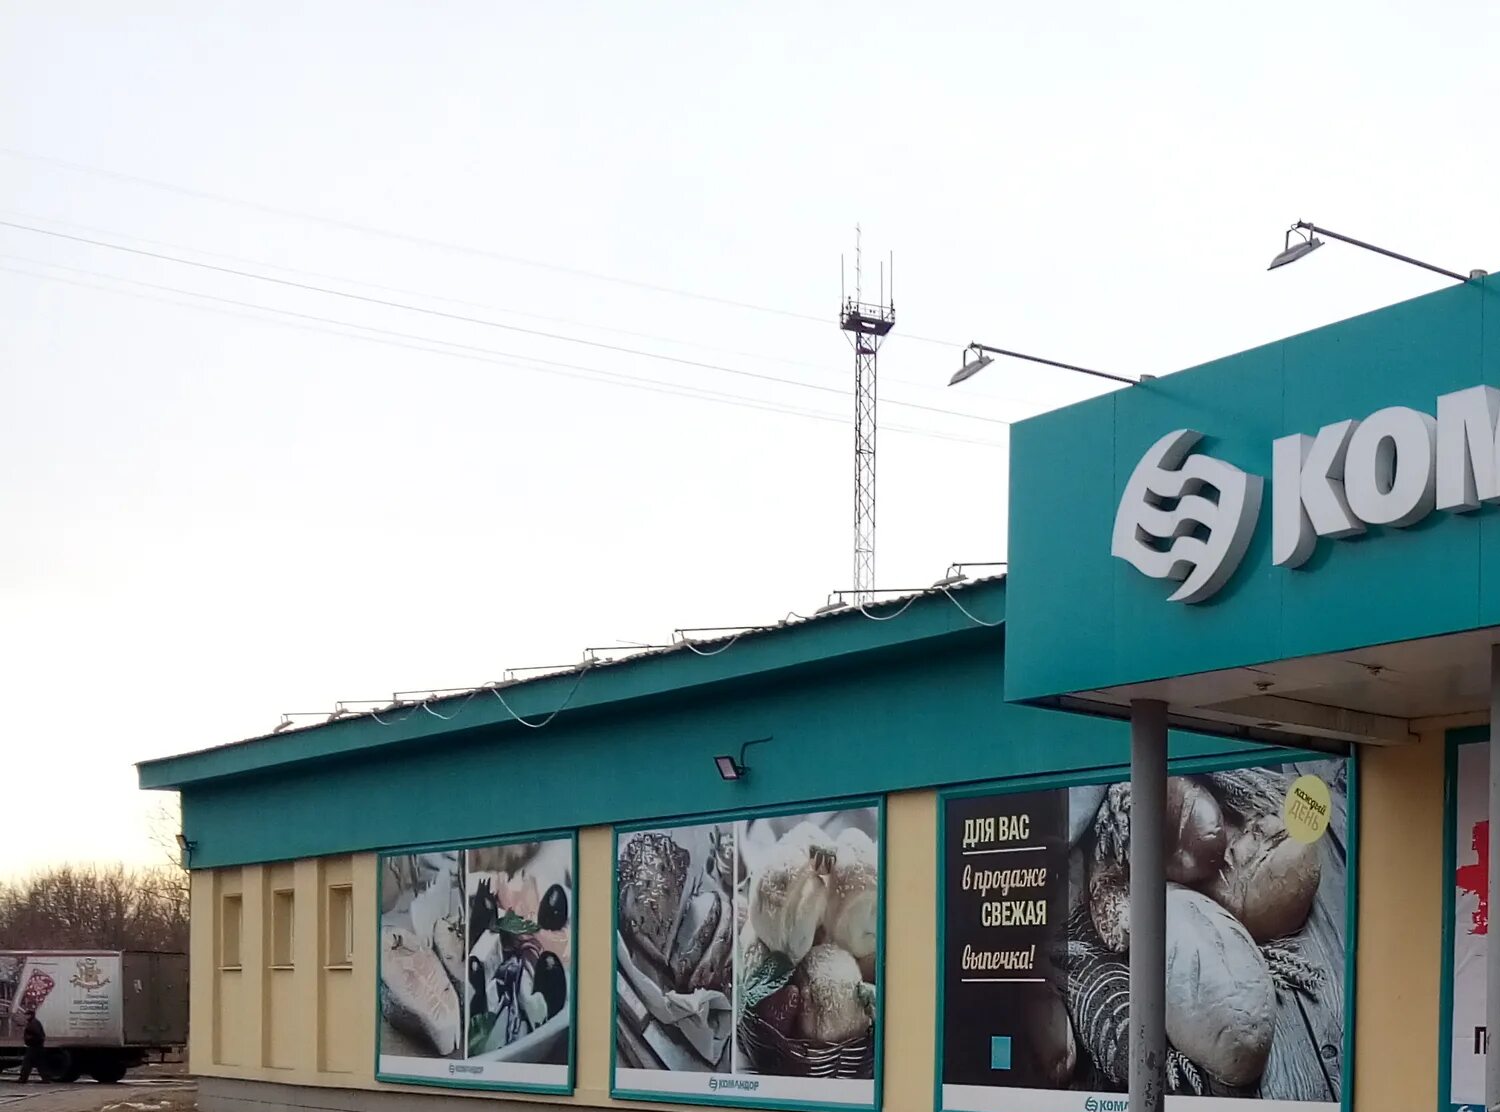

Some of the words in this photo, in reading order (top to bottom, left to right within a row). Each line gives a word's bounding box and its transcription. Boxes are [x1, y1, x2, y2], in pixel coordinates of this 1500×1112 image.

[963, 818, 995, 848] ДЛЯ
[999, 814, 1030, 841] ВАС
[1289, 800, 1319, 831] ДЕНЬ
[963, 864, 972, 890] в
[974, 867, 1047, 897] продаже
[982, 900, 1047, 926] СВЕЖАЯ
[962, 944, 1036, 970] выпечка!
